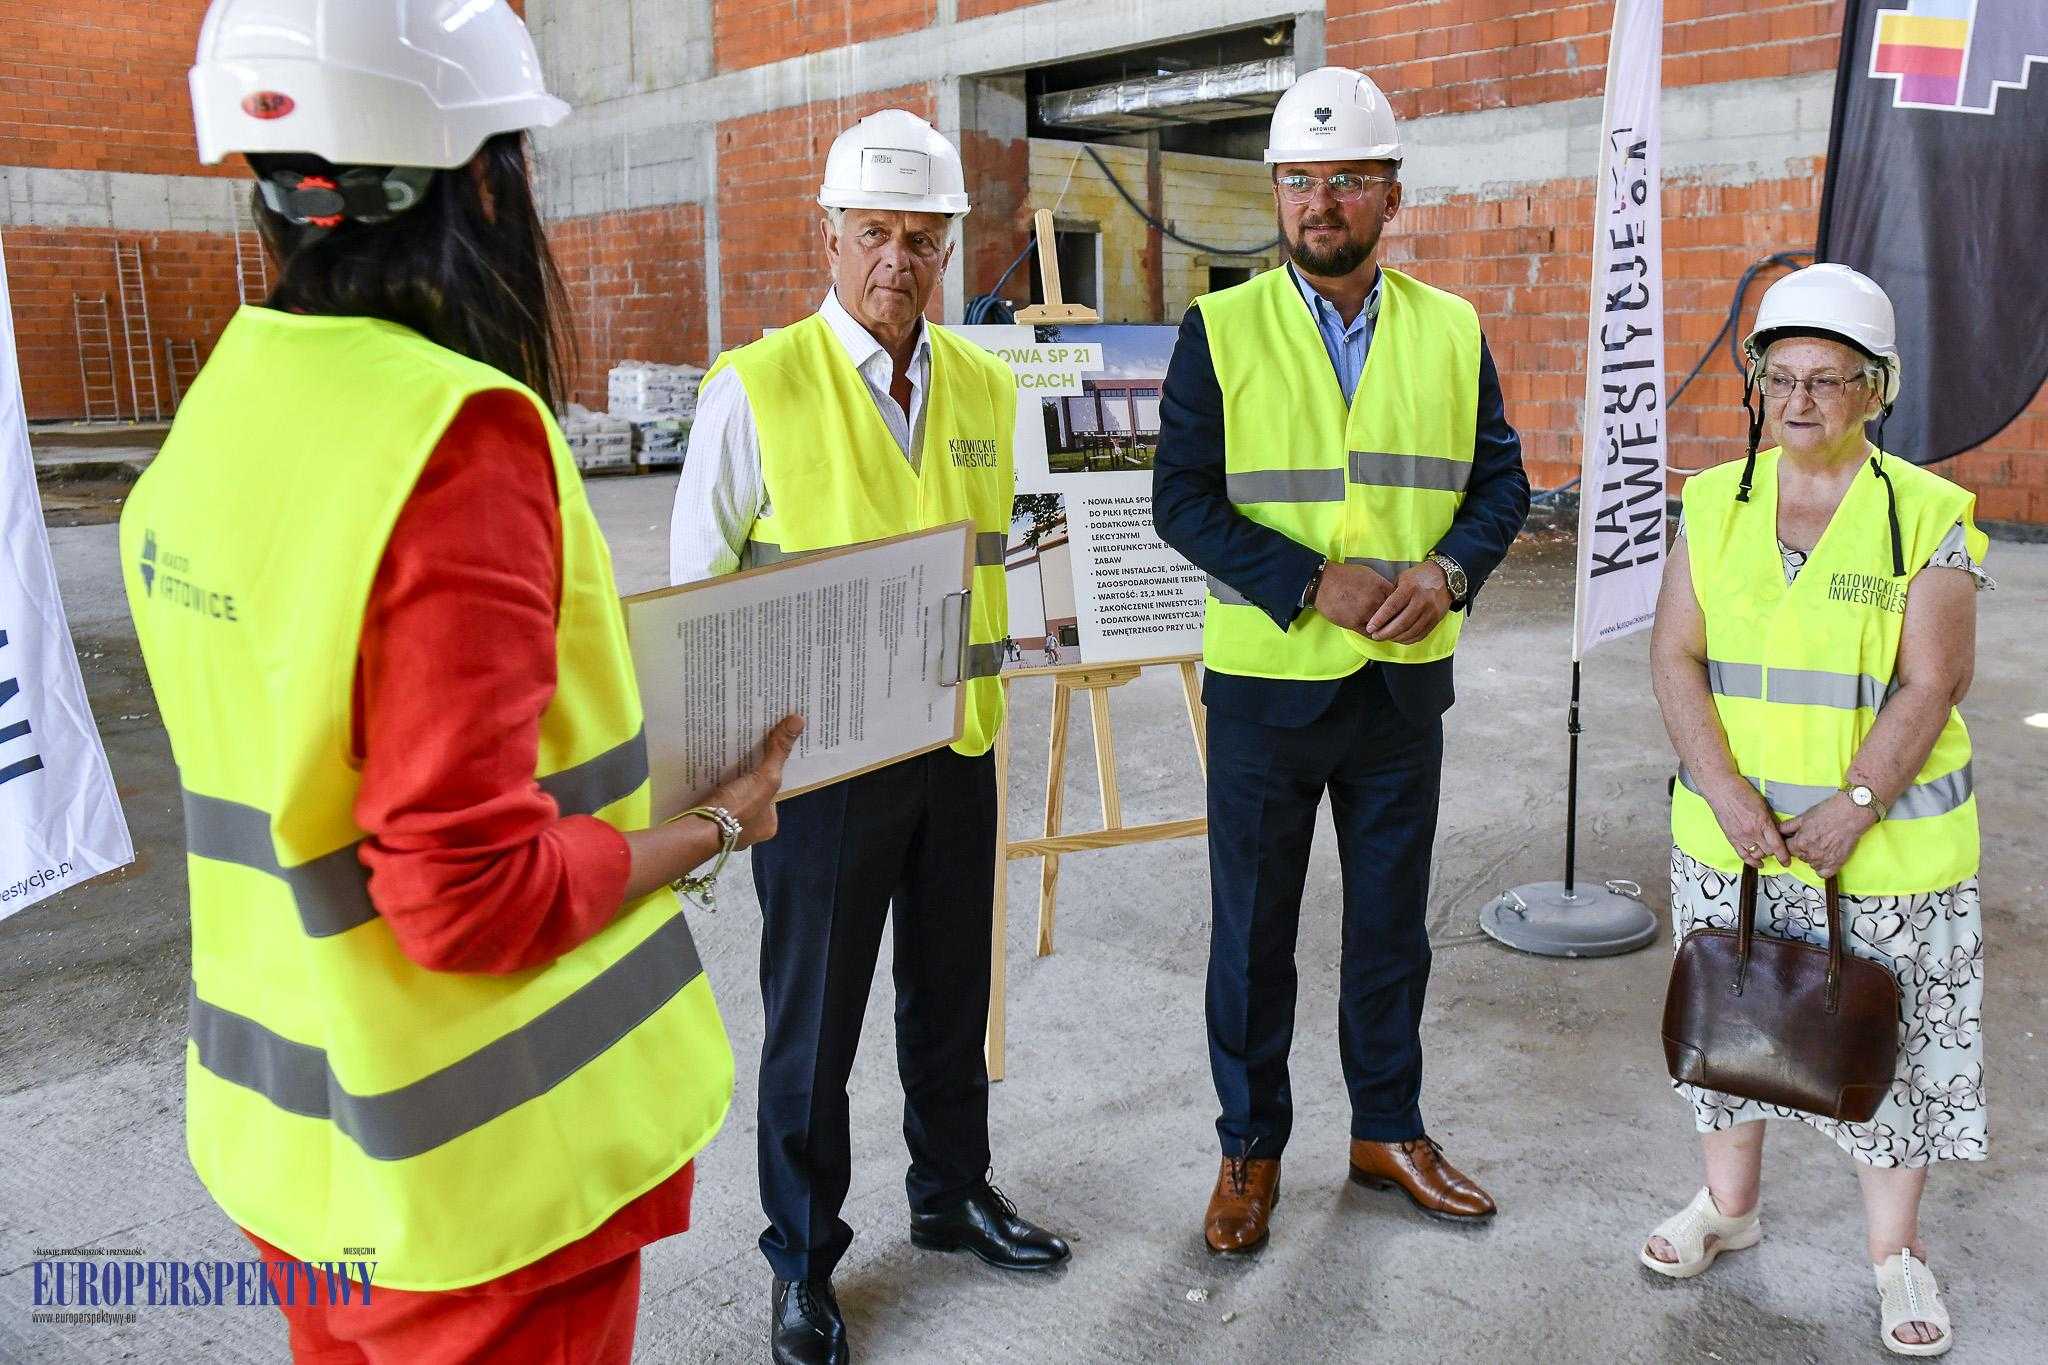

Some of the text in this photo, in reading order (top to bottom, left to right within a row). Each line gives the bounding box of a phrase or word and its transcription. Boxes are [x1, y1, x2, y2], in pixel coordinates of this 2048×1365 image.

[985, 349, 1090, 363] OWA SP 21
[1091, 520, 1140, 529] DODATKOWA
[1092, 532, 1140, 541] LEKCYJNYMI
[1093, 543, 1162, 553] WIELOFUNKCYJNE
[1095, 557, 1122, 565] ZABAW
[1096, 569, 1120, 577] NOWE
[1122, 565, 1168, 575] INSTALACJE,
[1097, 577, 1180, 589] ZAGOSPODAROWANIE
[1830, 573, 1901, 598] KATOWICKIE
[1100, 602, 1154, 613] ZAKOŃCZENIE
[1156, 599, 1202, 608] INWESTYCJI:
[1101, 615, 1151, 625] DODATKOWA
[1153, 612, 1202, 620] INWESTYCJA:
[1102, 625, 1165, 637] ZEWNĘTRZNEGO
[1166, 624, 1184, 632] PRZY
[0, 858, 73, 901] estycje.pl
